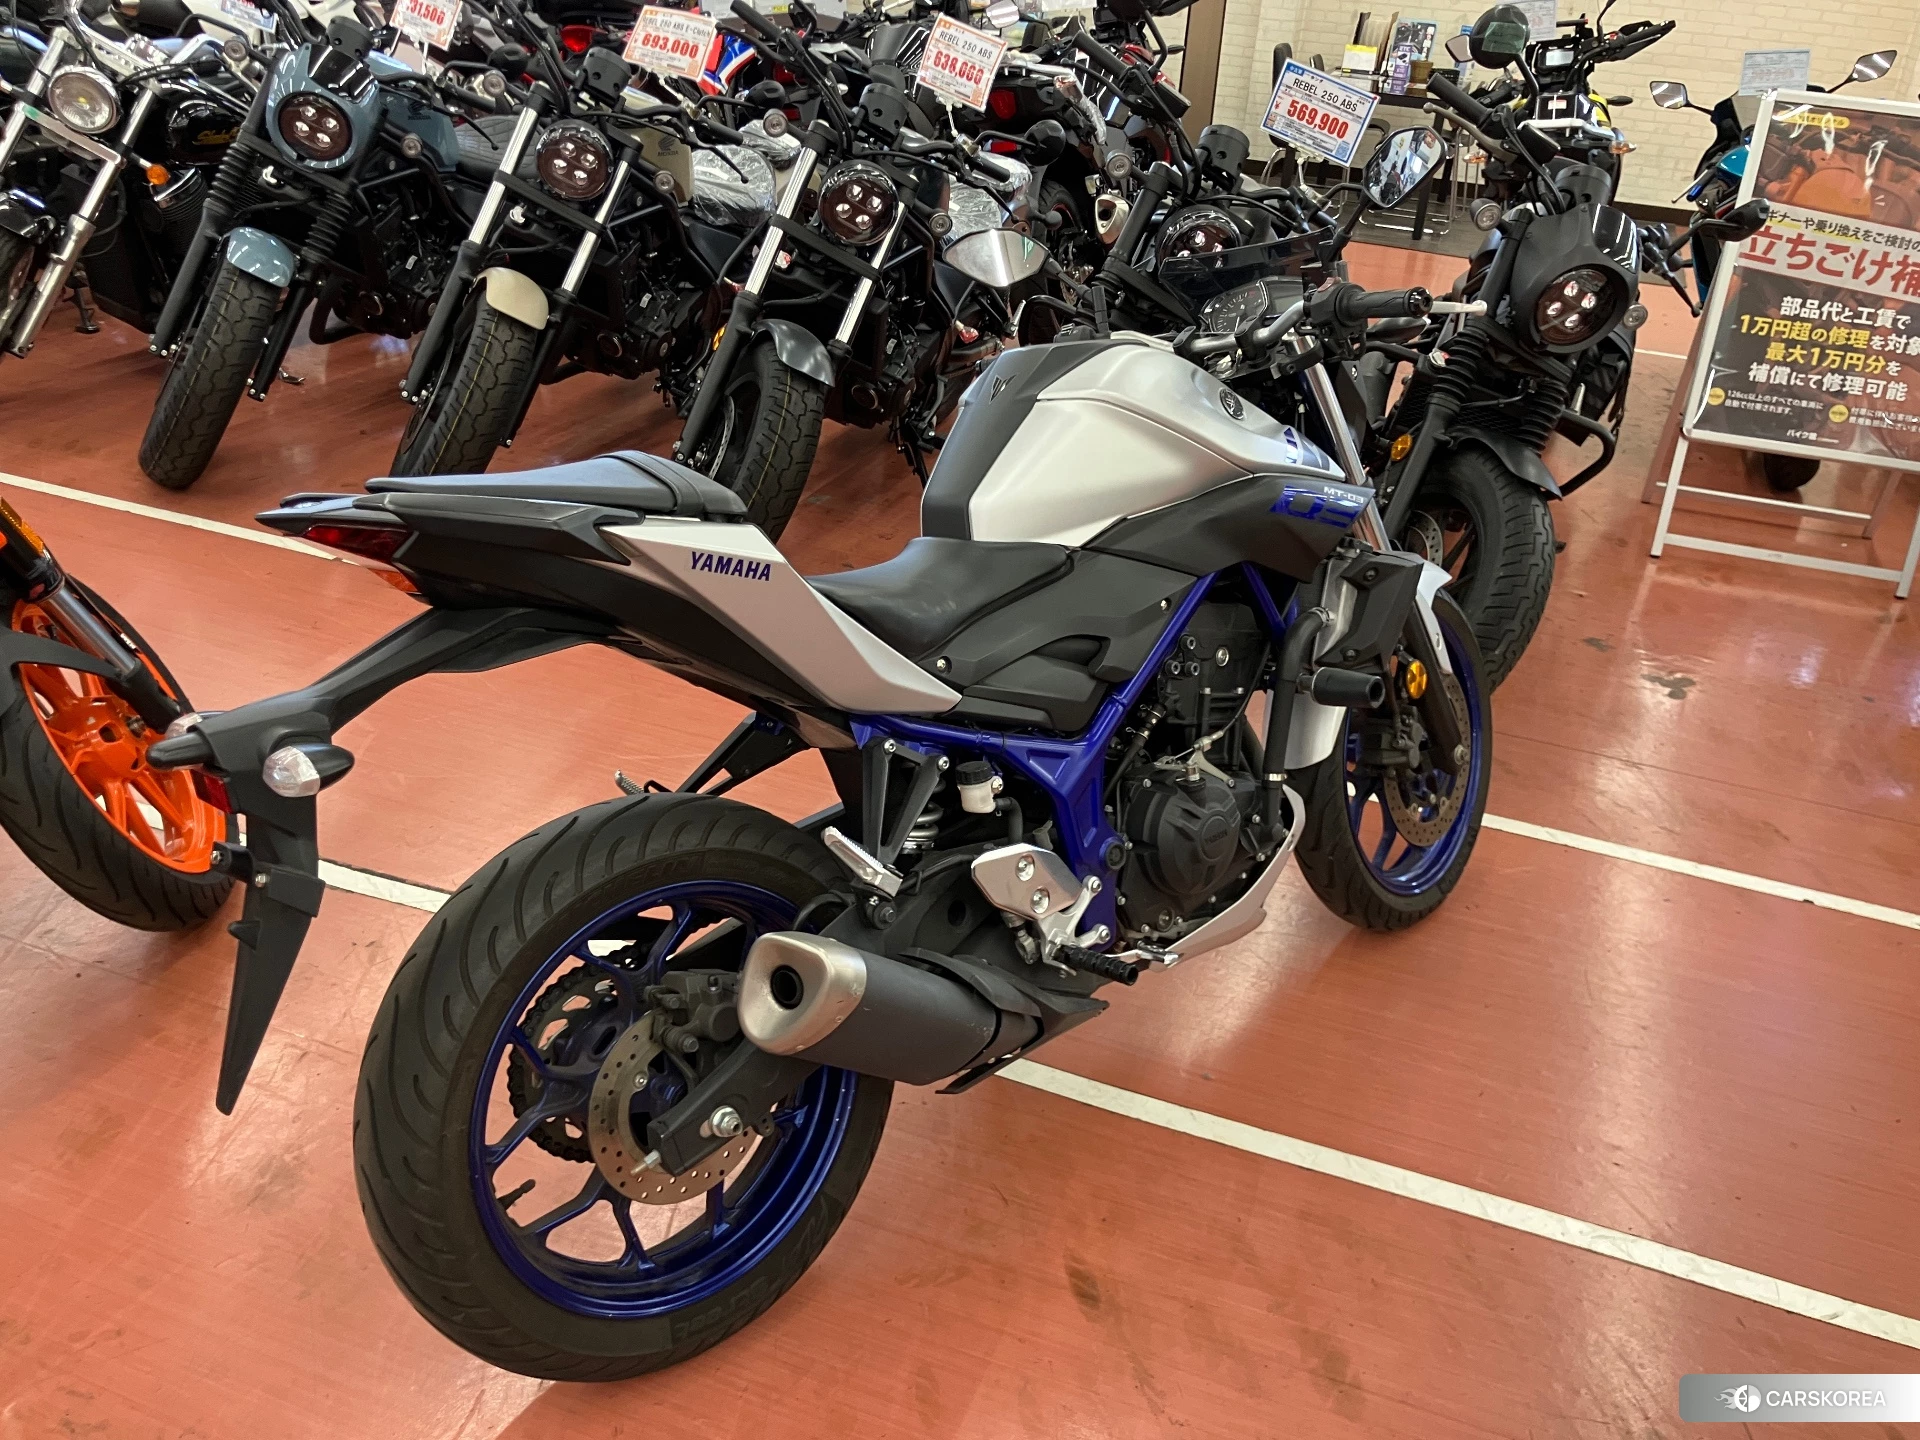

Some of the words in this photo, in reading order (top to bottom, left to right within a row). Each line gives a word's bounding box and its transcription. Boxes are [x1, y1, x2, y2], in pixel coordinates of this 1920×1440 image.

[406, 0, 445, 26] 31,500
[641, 33, 699, 59] 693,000
[939, 30, 960, 46] REBEL
[961, 41, 977, 53] 250
[978, 47, 993, 60] ABS
[933, 50, 985, 86] 638,000
[1292, 78, 1318, 96] REBEL
[1320, 90, 1339, 104] 250
[1340, 98, 1358, 112] ABS
[1287, 99, 1349, 139] 569,900
[1768, 209, 1920, 251] ギナーや乗り換えをご検討の
[1780, 295, 1911, 330] 部品代と工賃で
[1765, 341, 1902, 376] 最大1万円分を
[1748, 361, 1908, 402] 補償にて修理可能
[1323, 486, 1364, 504] MT-03
[691, 551, 771, 581] YAMAHA
